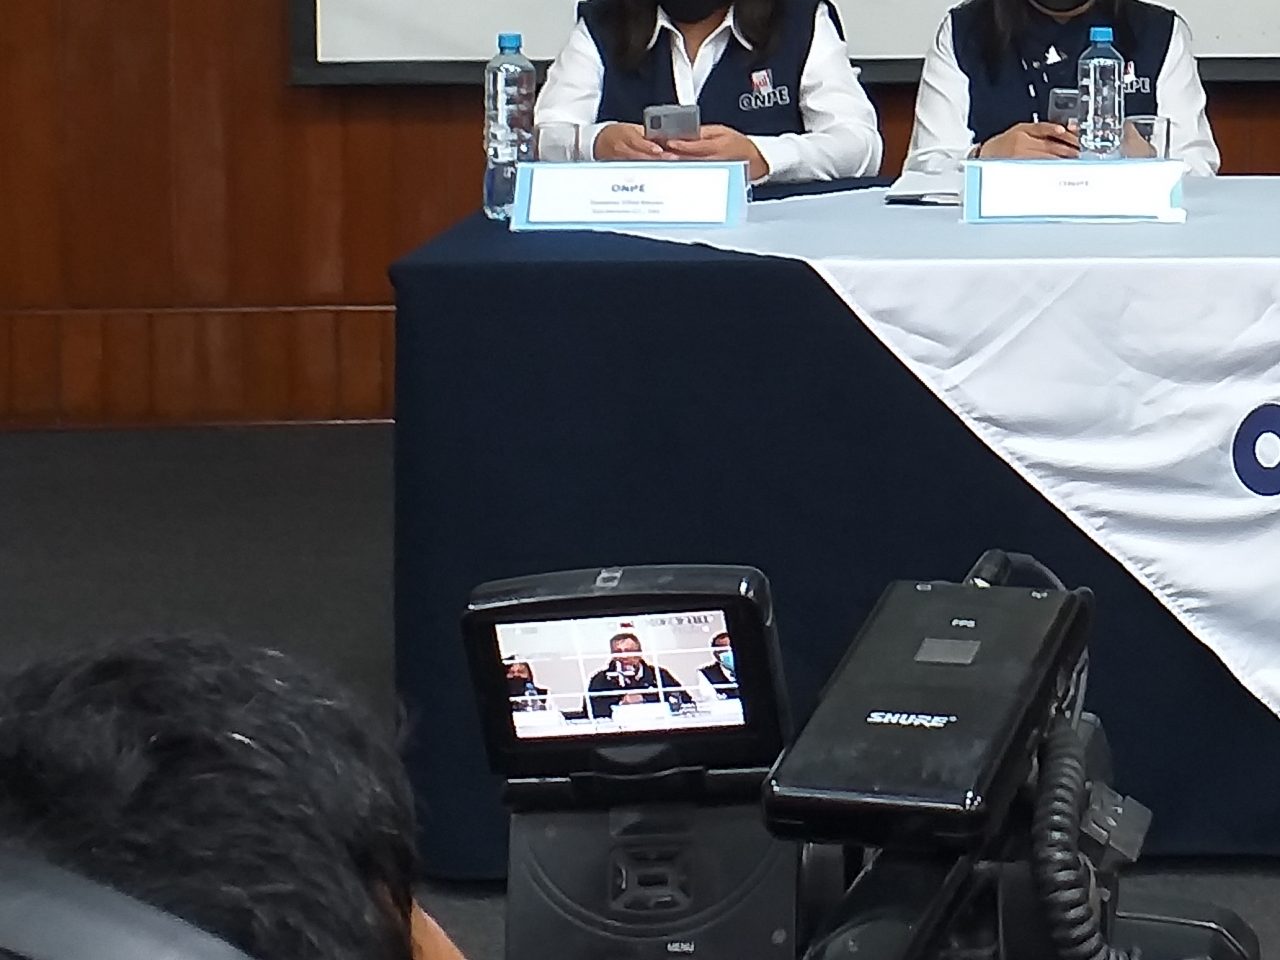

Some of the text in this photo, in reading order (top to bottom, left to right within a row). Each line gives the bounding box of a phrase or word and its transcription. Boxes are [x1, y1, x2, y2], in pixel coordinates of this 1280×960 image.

[739, 86, 790, 111] ONPE
[611, 184, 645, 193] ONPE
[866, 711, 949, 729] SHURE
